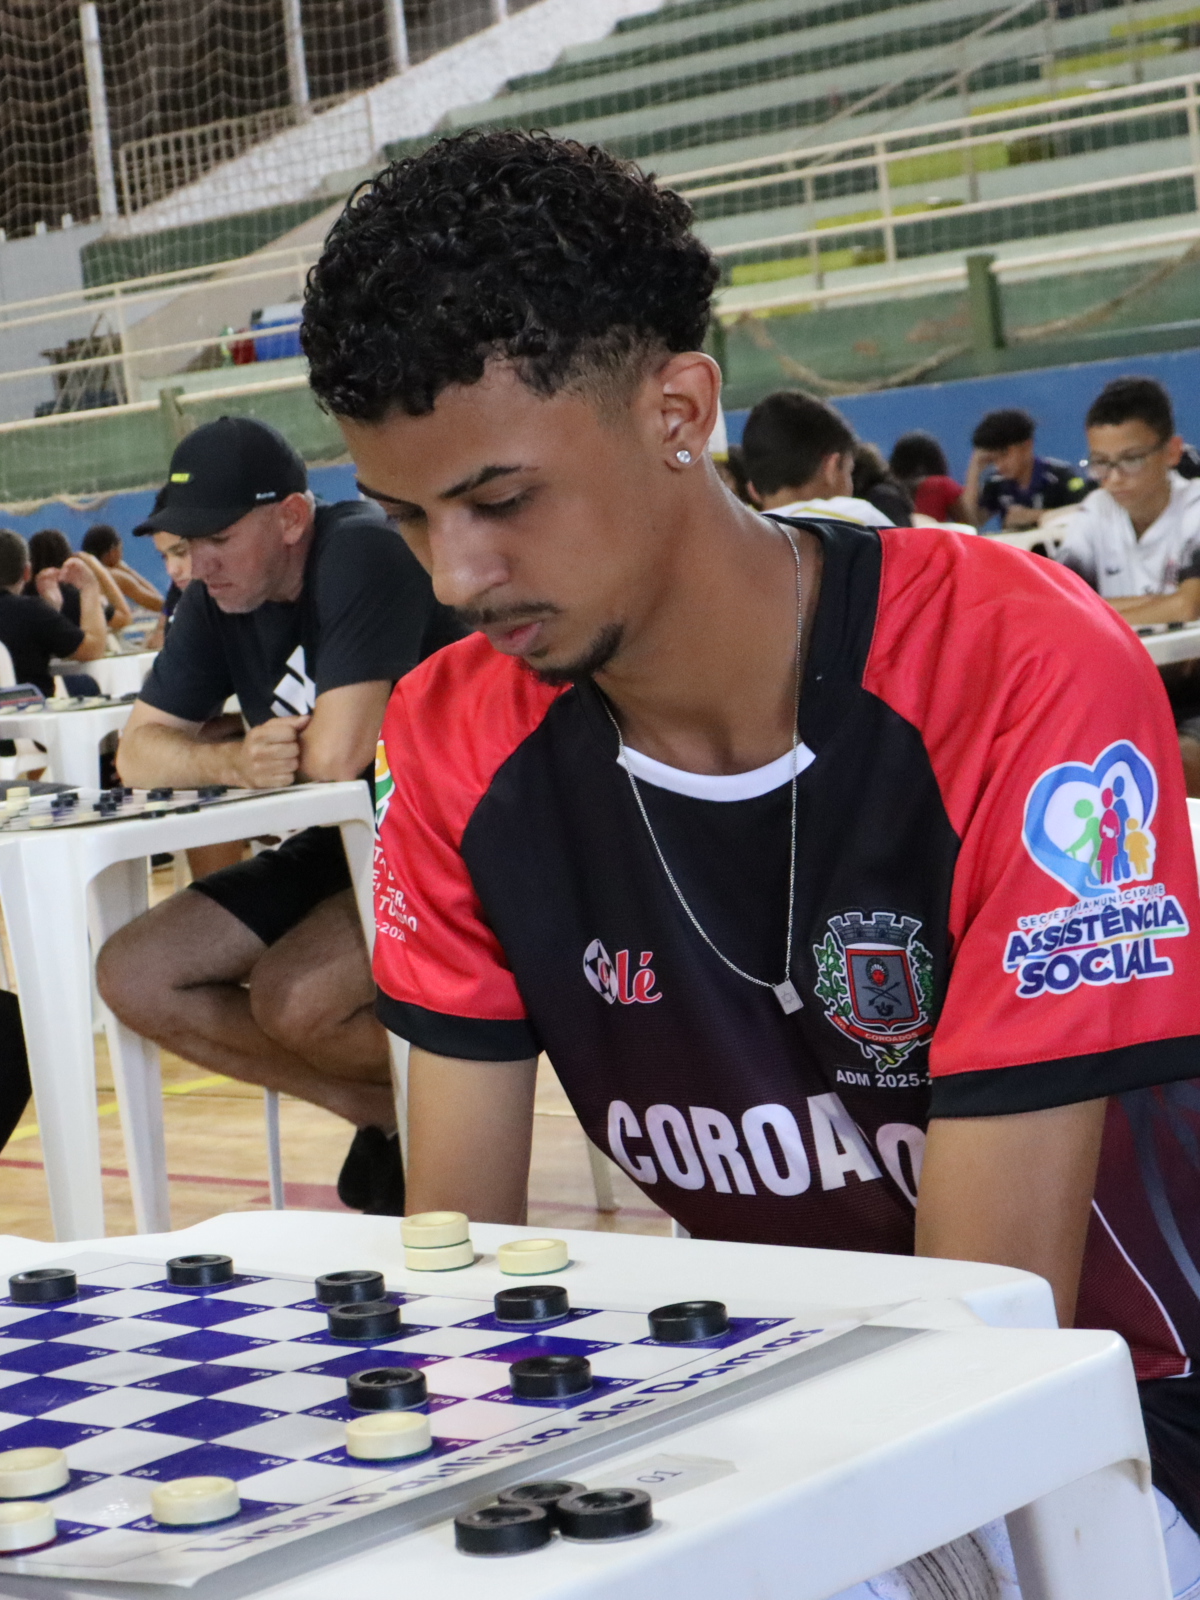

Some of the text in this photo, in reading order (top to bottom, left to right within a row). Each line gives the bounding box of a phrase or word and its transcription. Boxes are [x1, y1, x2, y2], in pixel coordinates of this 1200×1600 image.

[1007, 899, 1184, 963] ASSISTÊNCIA
[1020, 938, 1169, 996] SOCIAL
[836, 1069, 871, 1087] ADM
[180, 1328, 825, 1552] Liga Paulista de Damas
[636, 1470, 683, 1484] 01
